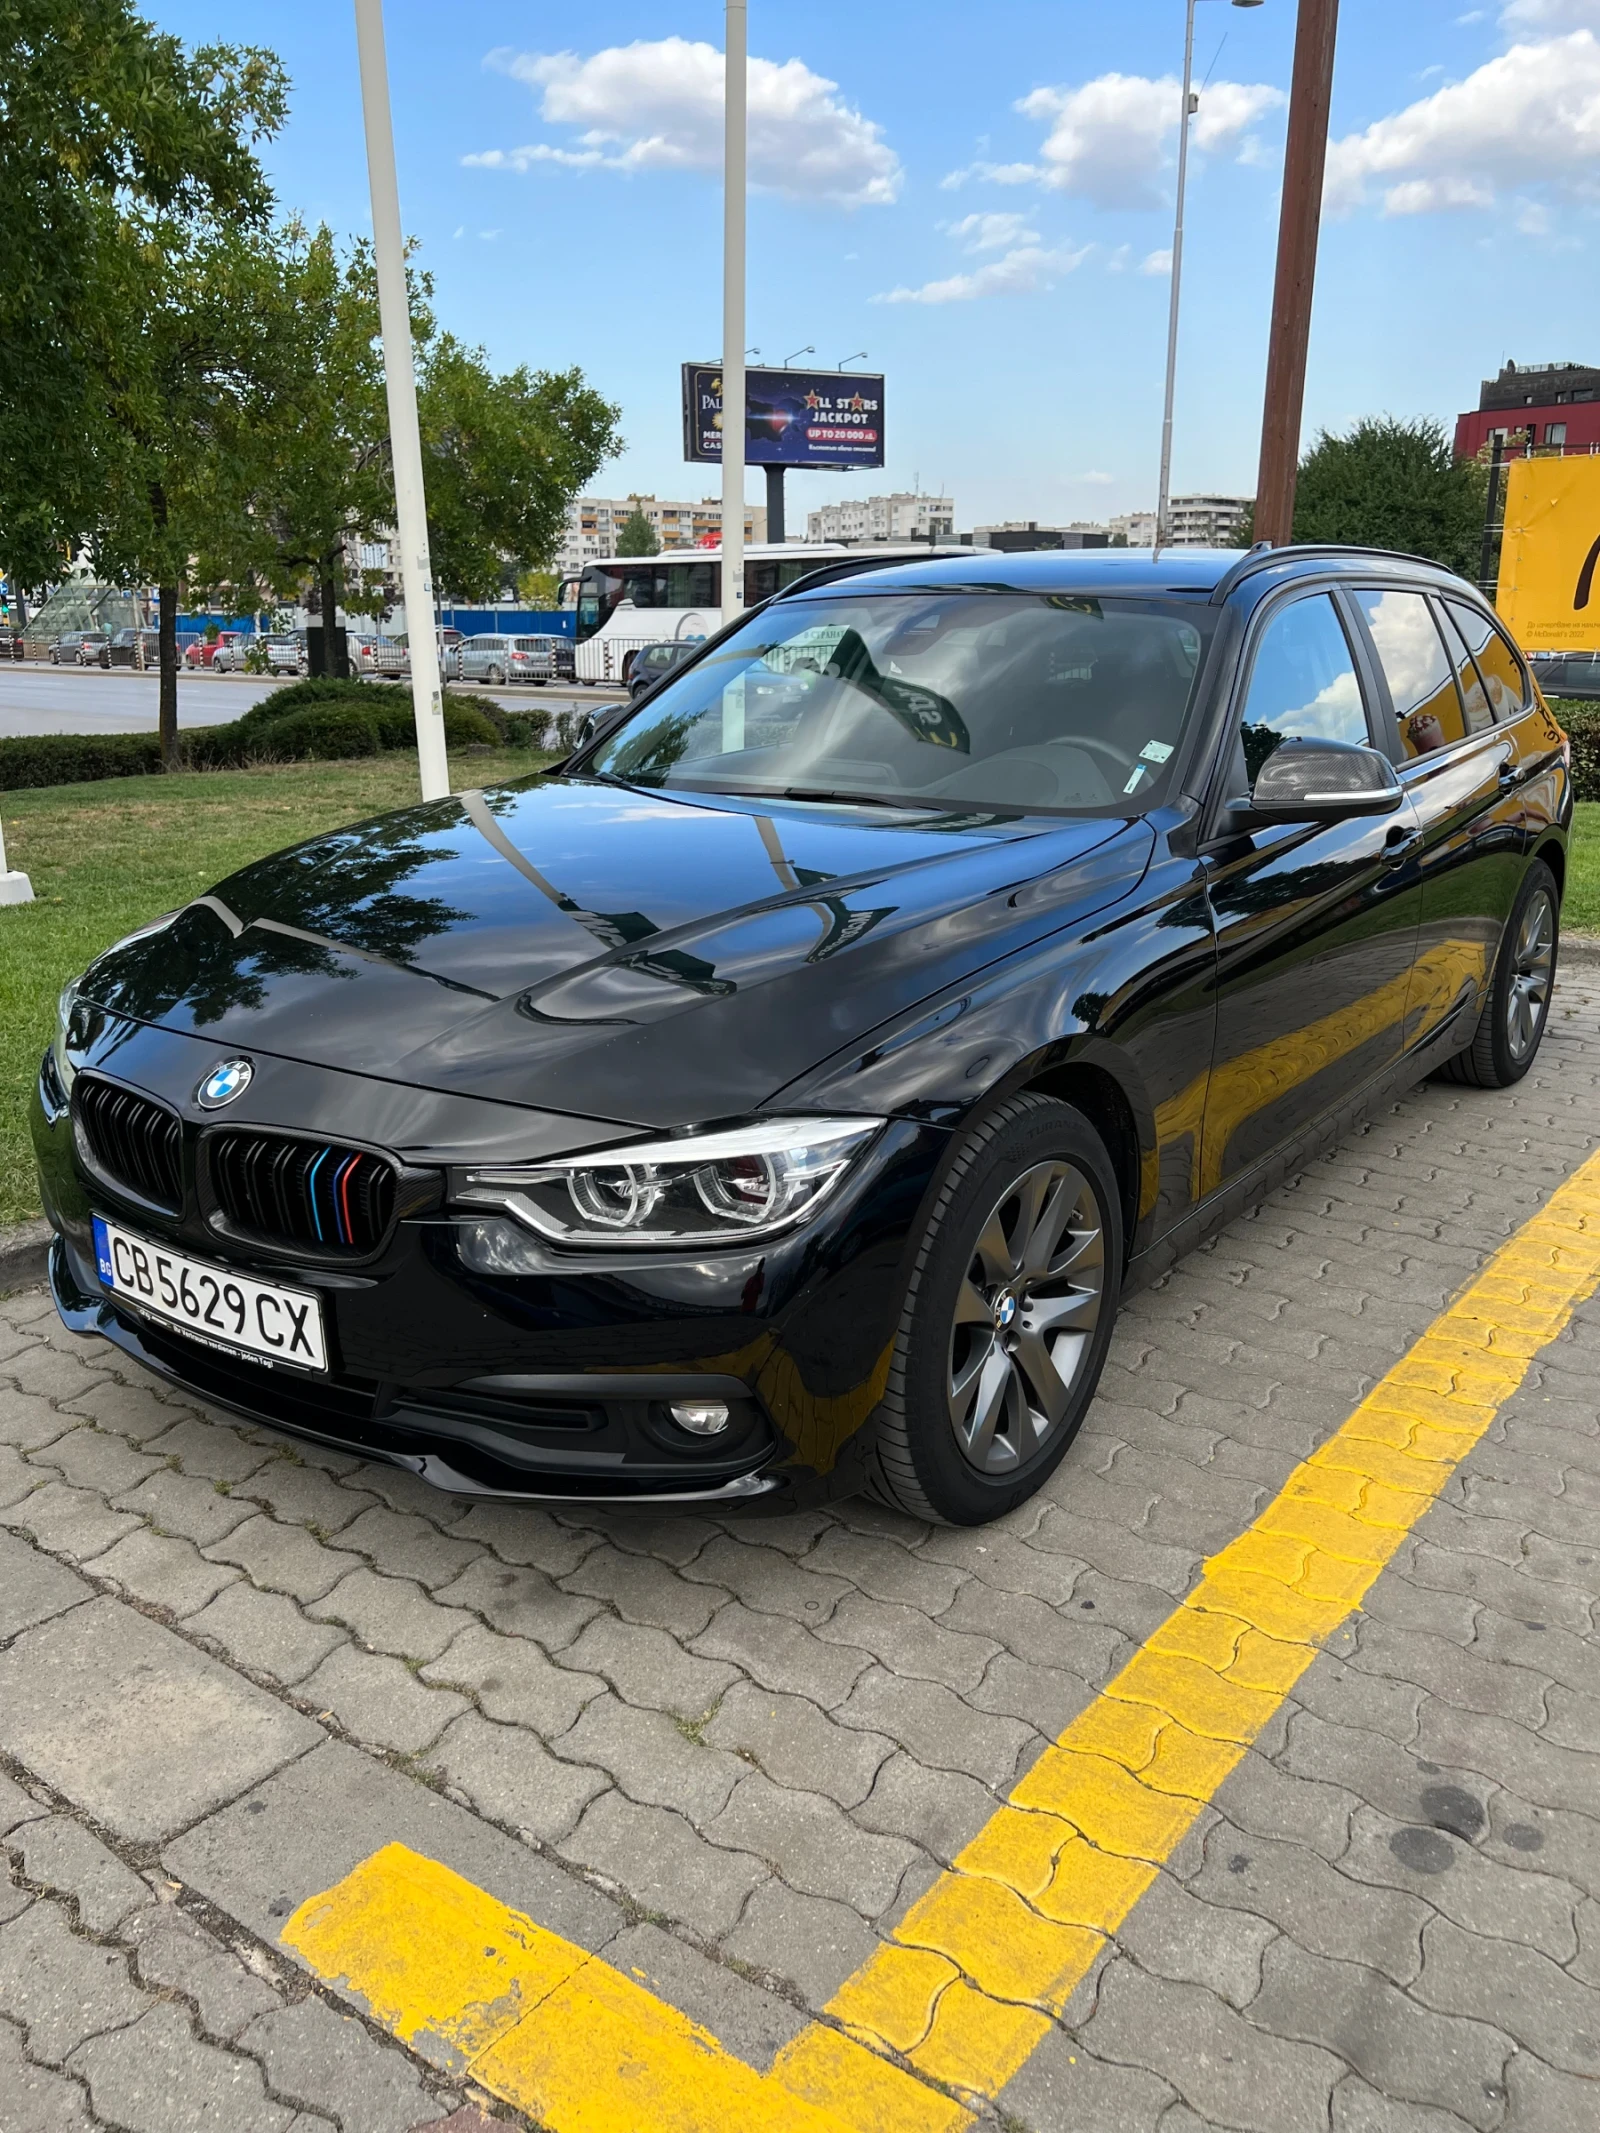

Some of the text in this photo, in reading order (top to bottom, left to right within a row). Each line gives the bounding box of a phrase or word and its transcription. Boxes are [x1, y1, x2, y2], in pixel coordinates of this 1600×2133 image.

[812, 412, 868, 424] JACKPOT
[807, 429, 821, 438] UP
[822, 430, 834, 439] TO
[834, 430, 846, 439] 20
[846, 430, 864, 440] 000
[1534, 630, 1567, 638] McDonald's
[1569, 630, 1584, 638] 2022
[99, 1258, 112, 1277] BG
[181, 1328, 208, 1346] Vertrauen
